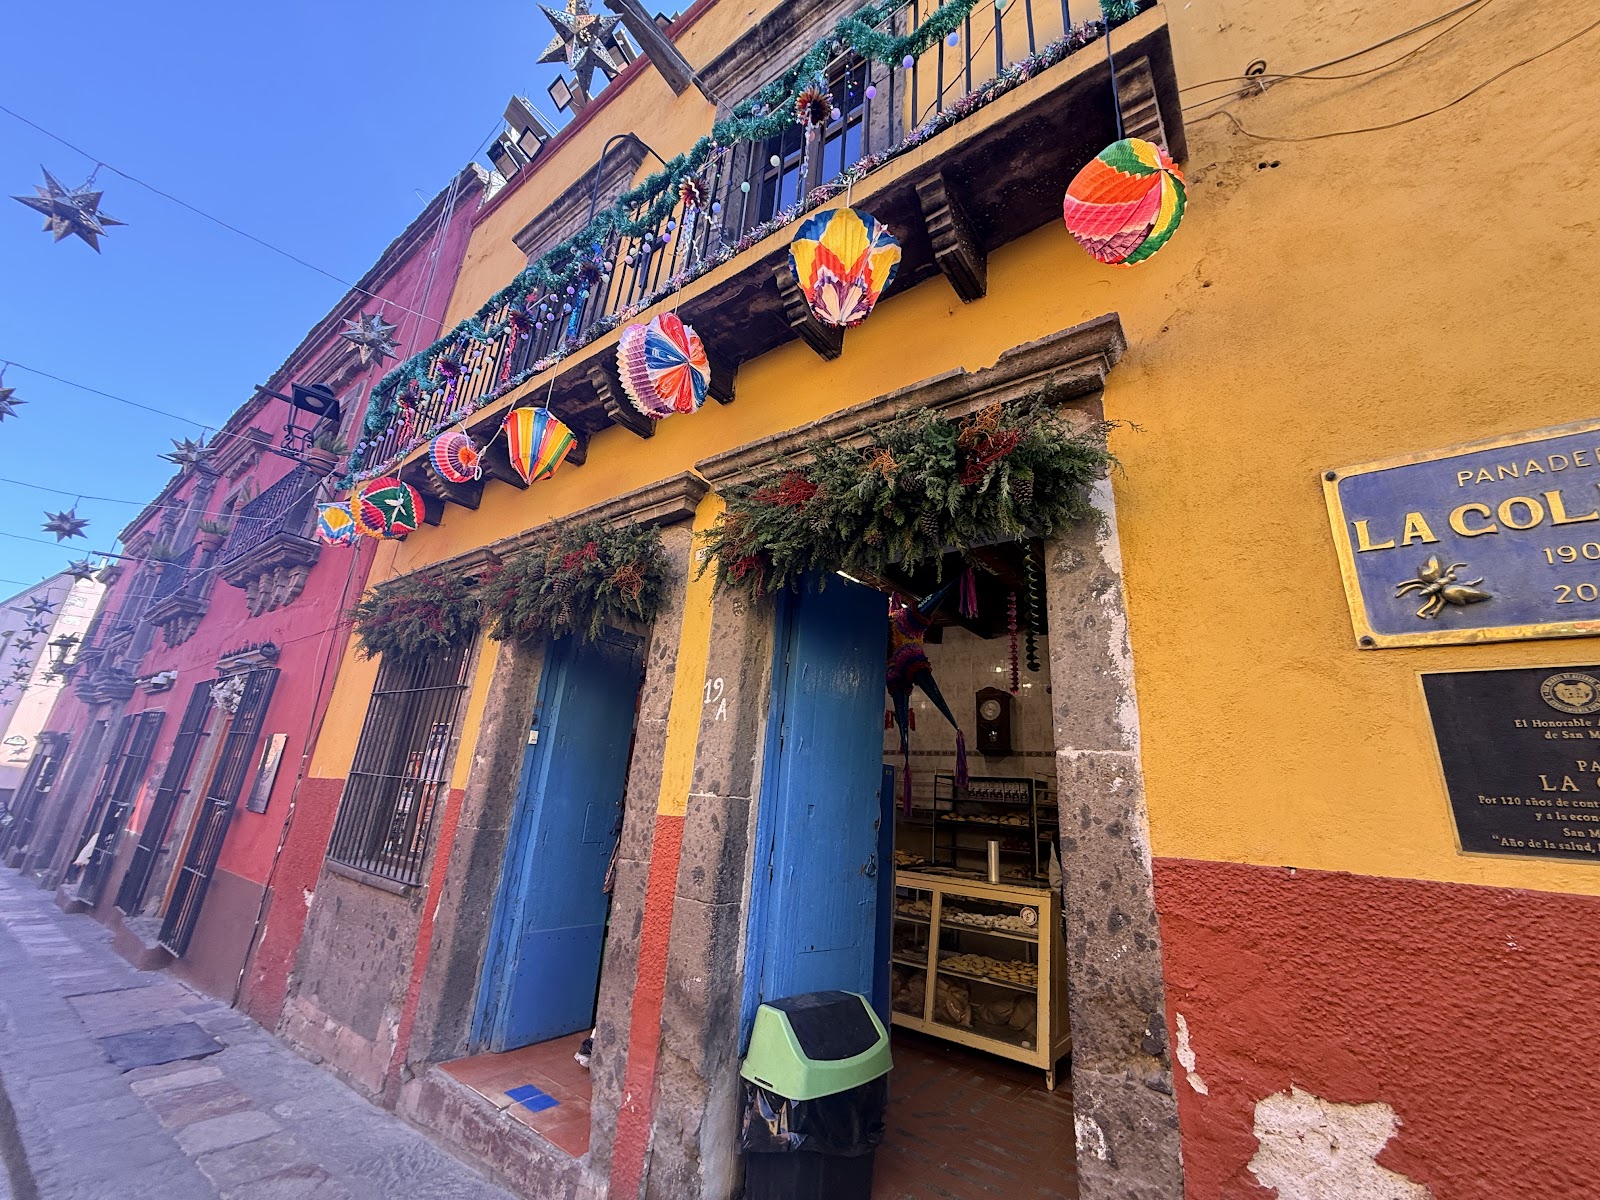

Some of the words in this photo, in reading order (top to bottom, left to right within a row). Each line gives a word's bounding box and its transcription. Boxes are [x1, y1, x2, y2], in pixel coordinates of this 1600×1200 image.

[1353, 511, 1440, 552] LA
[1449, 485, 1600, 537] COL
[1542, 542, 1600, 565] 190
[1553, 583, 1598, 604] 20
[704, 677, 724, 704] 19
[714, 697, 727, 721] A
[1514, 719, 1528, 728] El
[1531, 718, 1592, 728] Honorable
[1544, 731, 1558, 739] de
[1561, 730, 1584, 739] San
[1576, 760, 1600, 772] PA
[1538, 774, 1580, 792] LA
[1478, 795, 1497, 804] Por
[1500, 796, 1521, 805] 120
[1525, 797, 1553, 807] años
[1555, 797, 1569, 807] de
[1535, 812, 1542, 822] y
[1555, 811, 1568, 820] la
[1569, 813, 1600, 822] econ
[1563, 827, 1586, 838] San
[1528, 838, 1542, 849] de
[1543, 839, 1556, 849] la
[1558, 841, 1596, 854] salud,
